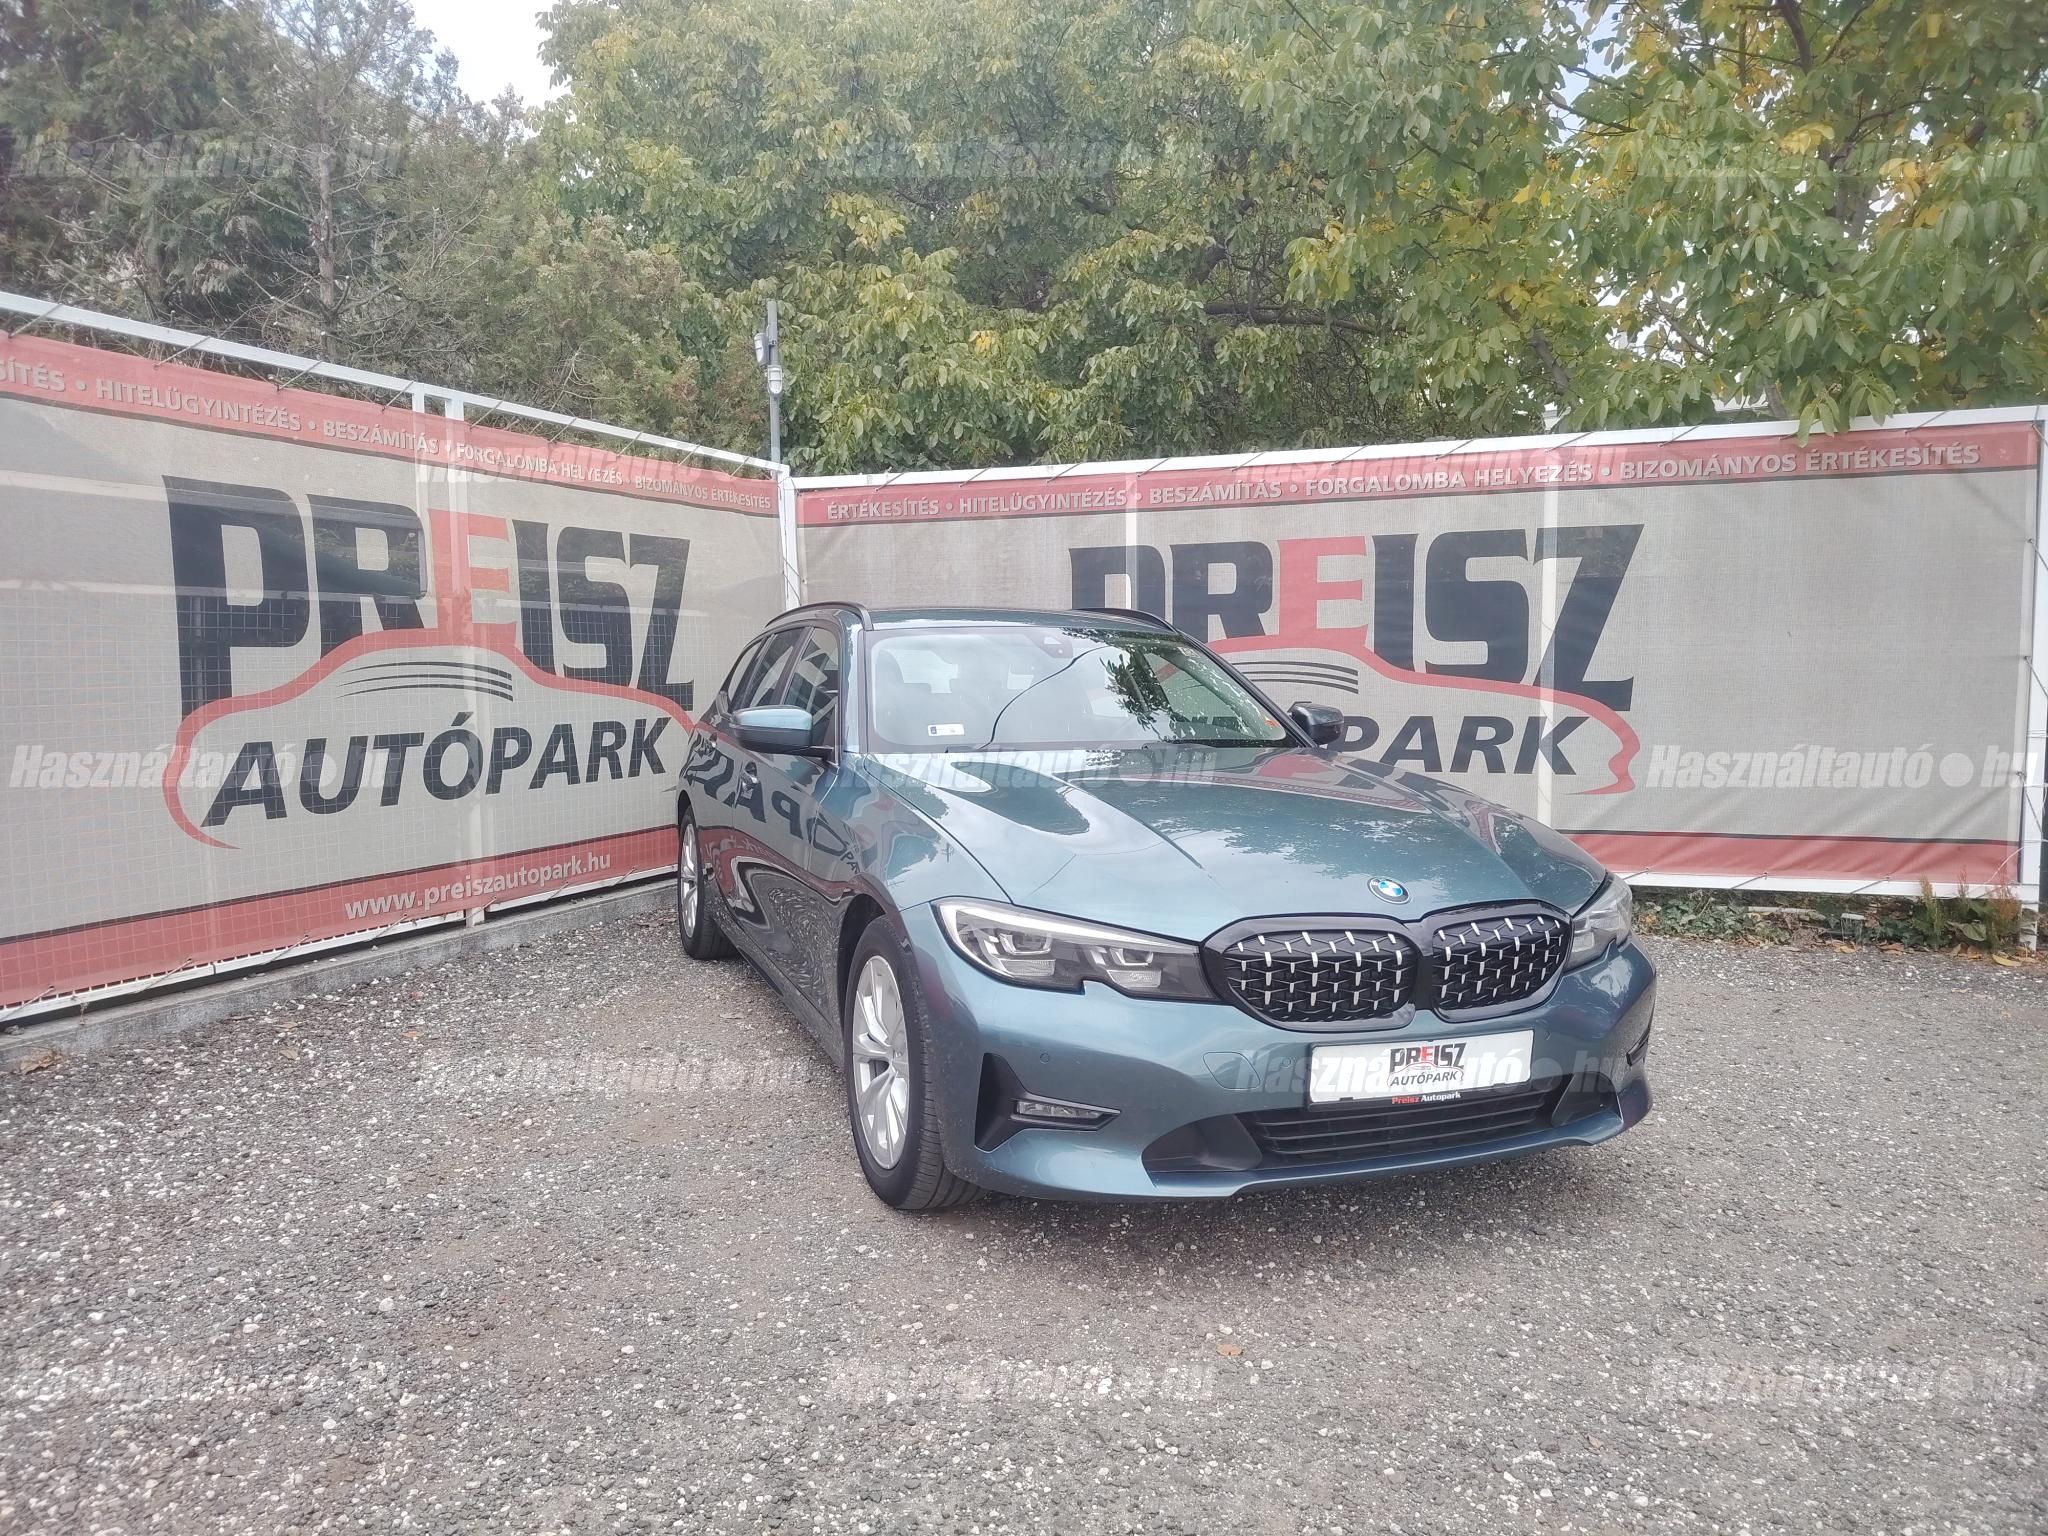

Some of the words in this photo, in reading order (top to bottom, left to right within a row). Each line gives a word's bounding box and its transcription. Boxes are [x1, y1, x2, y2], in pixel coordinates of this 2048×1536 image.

[96, 378, 301, 432] HITELÜGYINTÉZÉS
[323, 419, 439, 455] BESZÁMÍTÁS
[456, 443, 558, 475] FORGALOMBA
[561, 463, 623, 486] HELYEZÉS
[635, 475, 708, 500] BIZOMÁNYOS
[711, 485, 771, 509] ÉRTÉKESÍTÉS
[827, 494, 940, 521] ÉRTÉKESÍTÉS
[959, 487, 1127, 514] HITELÜGYINTÉZÉS
[1150, 478, 1283, 504] BESZÁMÍTÁS
[1306, 470, 1467, 497] FORGALOMBA
[1474, 461, 1593, 487] HELYEZÉS
[1619, 453, 1797, 481] BIZOMÁNYOS
[1805, 442, 1981, 472] ÉRTÉKESÍTÉS
[162, 475, 694, 717] PREISZ
[201, 710, 672, 828] AUTÓPARK
[345, 851, 611, 919] www.preiszautopark.hu
[1390, 1043, 1467, 1073] PREISZ
[1390, 1071, 1458, 1087] AUTÓPARK
[1391, 1096, 1419, 1104] Preisz
[1421, 1091, 1461, 1103] Autopark
